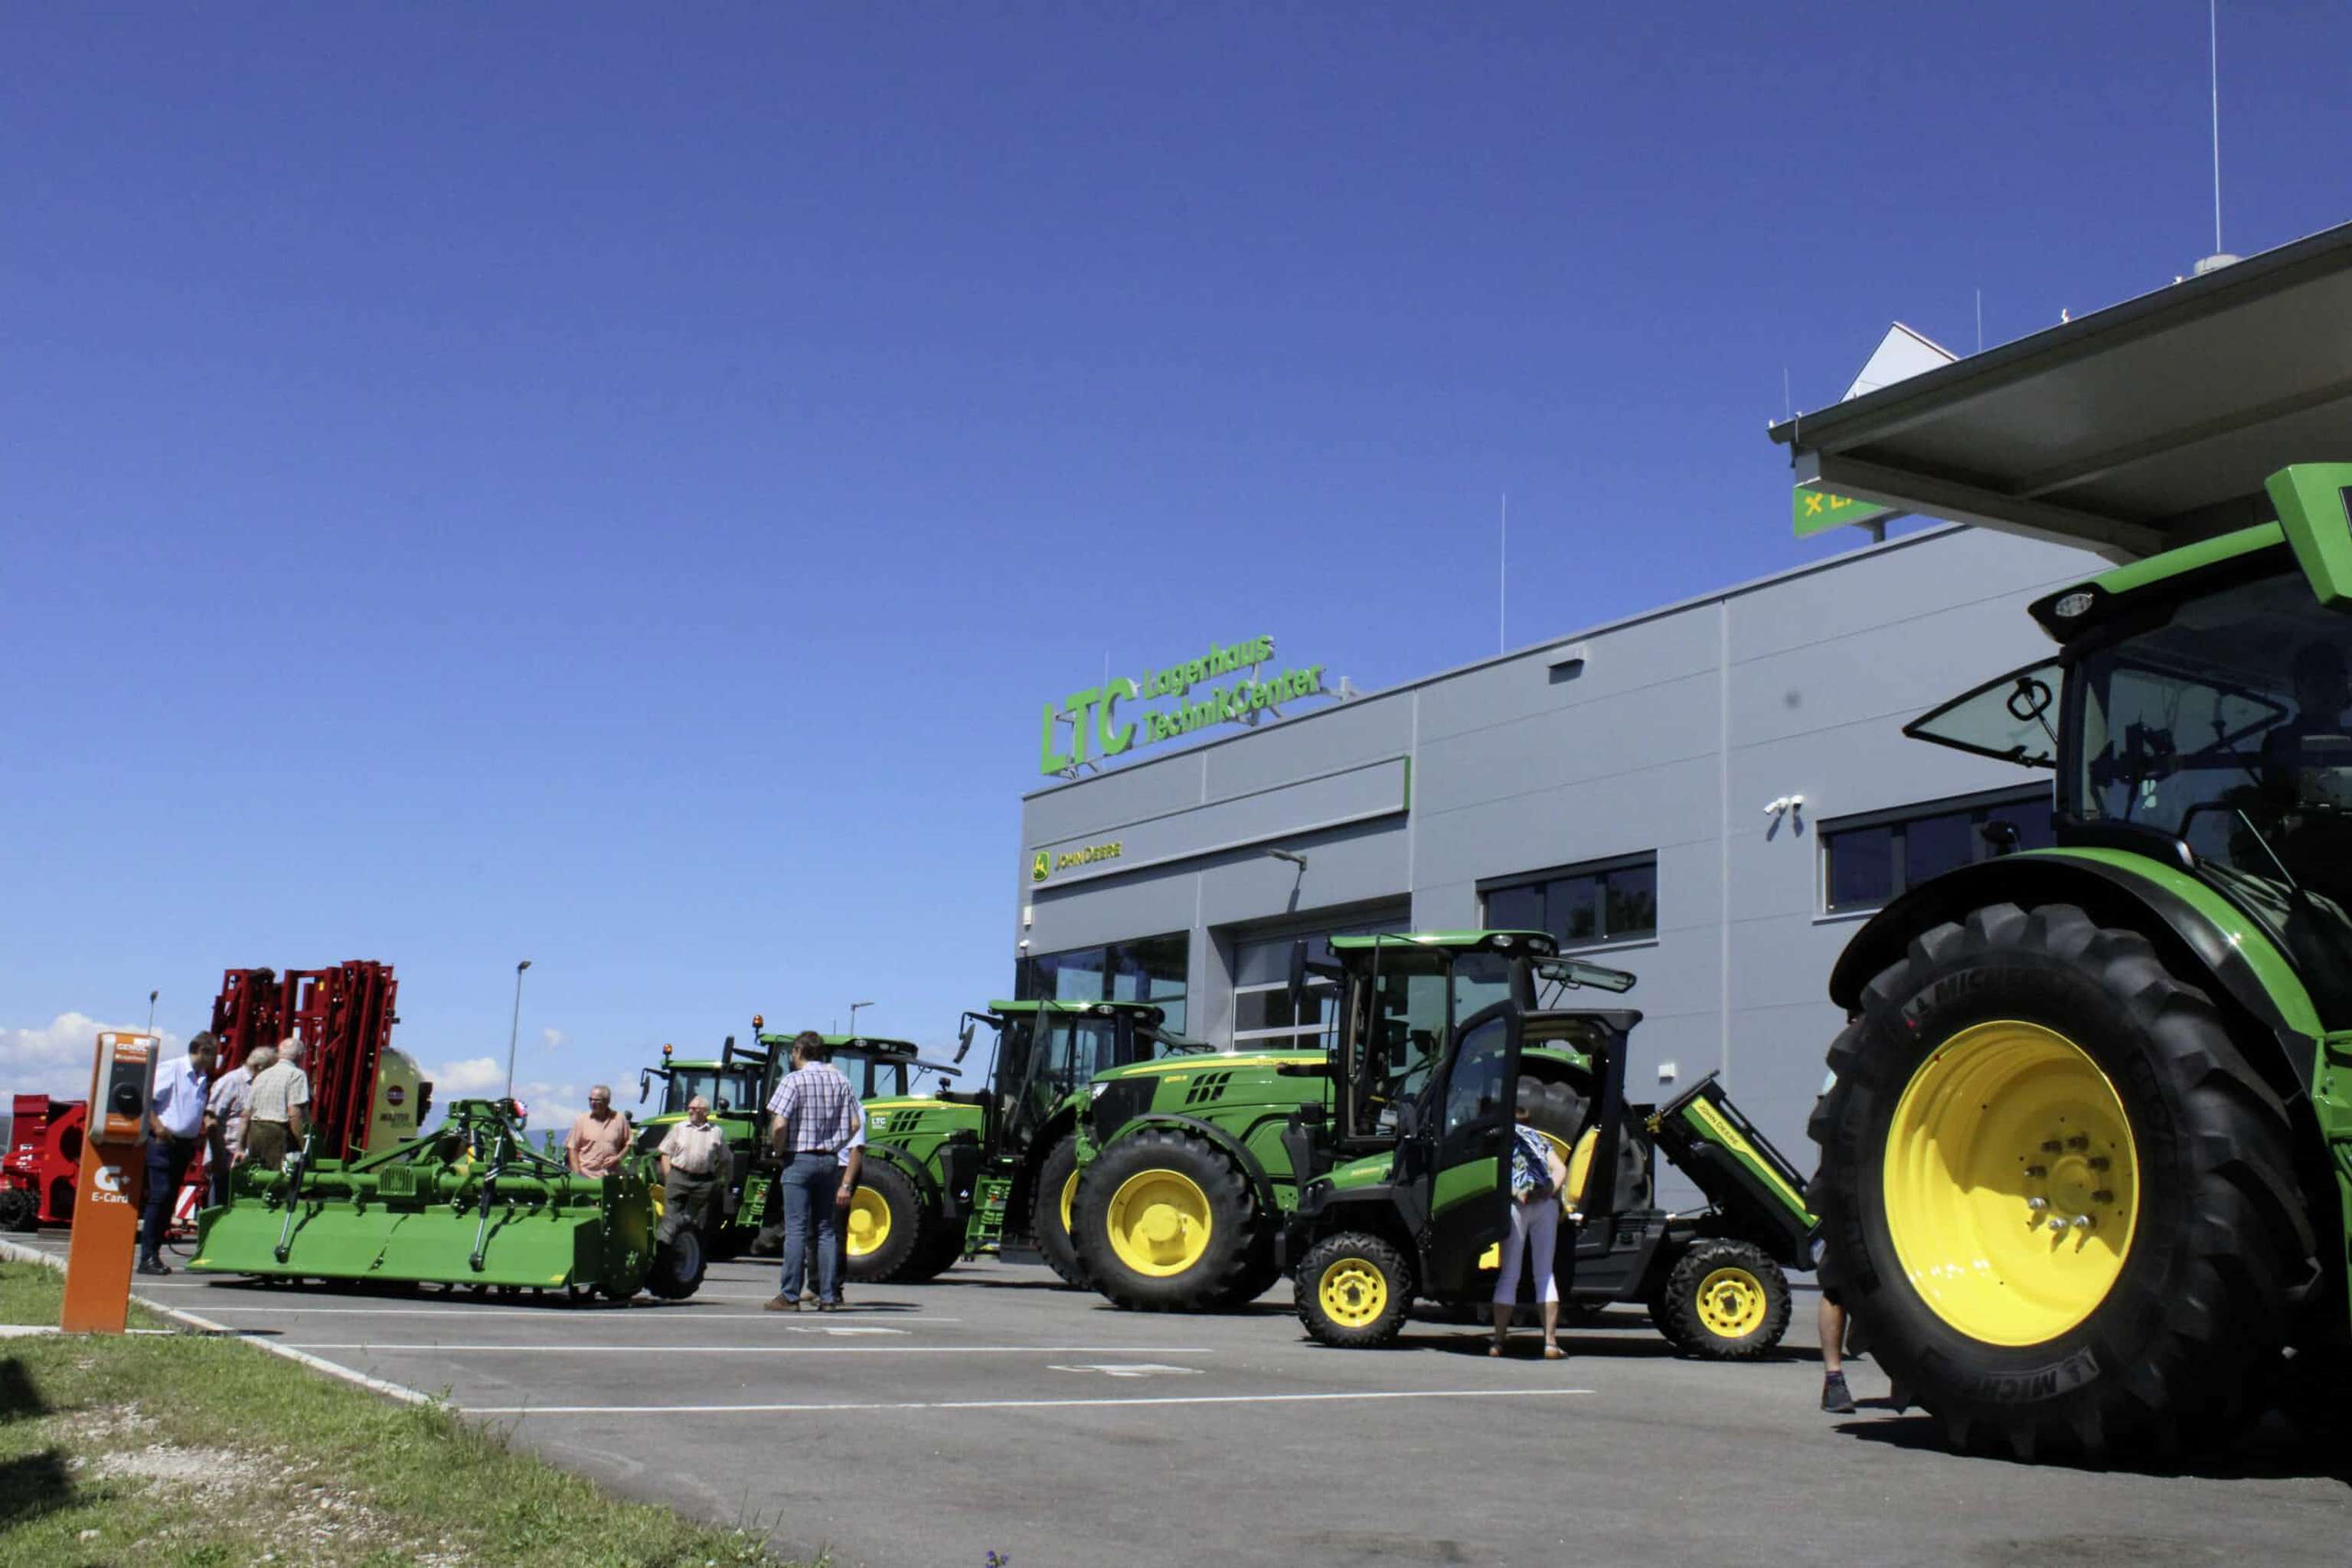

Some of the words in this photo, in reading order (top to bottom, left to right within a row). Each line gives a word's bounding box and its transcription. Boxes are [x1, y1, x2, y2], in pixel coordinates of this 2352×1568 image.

[1144, 635, 1274, 700] Lagerhaus
[1041, 677, 1136, 774] LTC
[1142, 665, 1321, 743] TechnikCenter
[1698, 1104, 1717, 1123] JOHN
[1716, 1121, 1739, 1146] DEERE
[91, 1191, 129, 1204] E-Card
